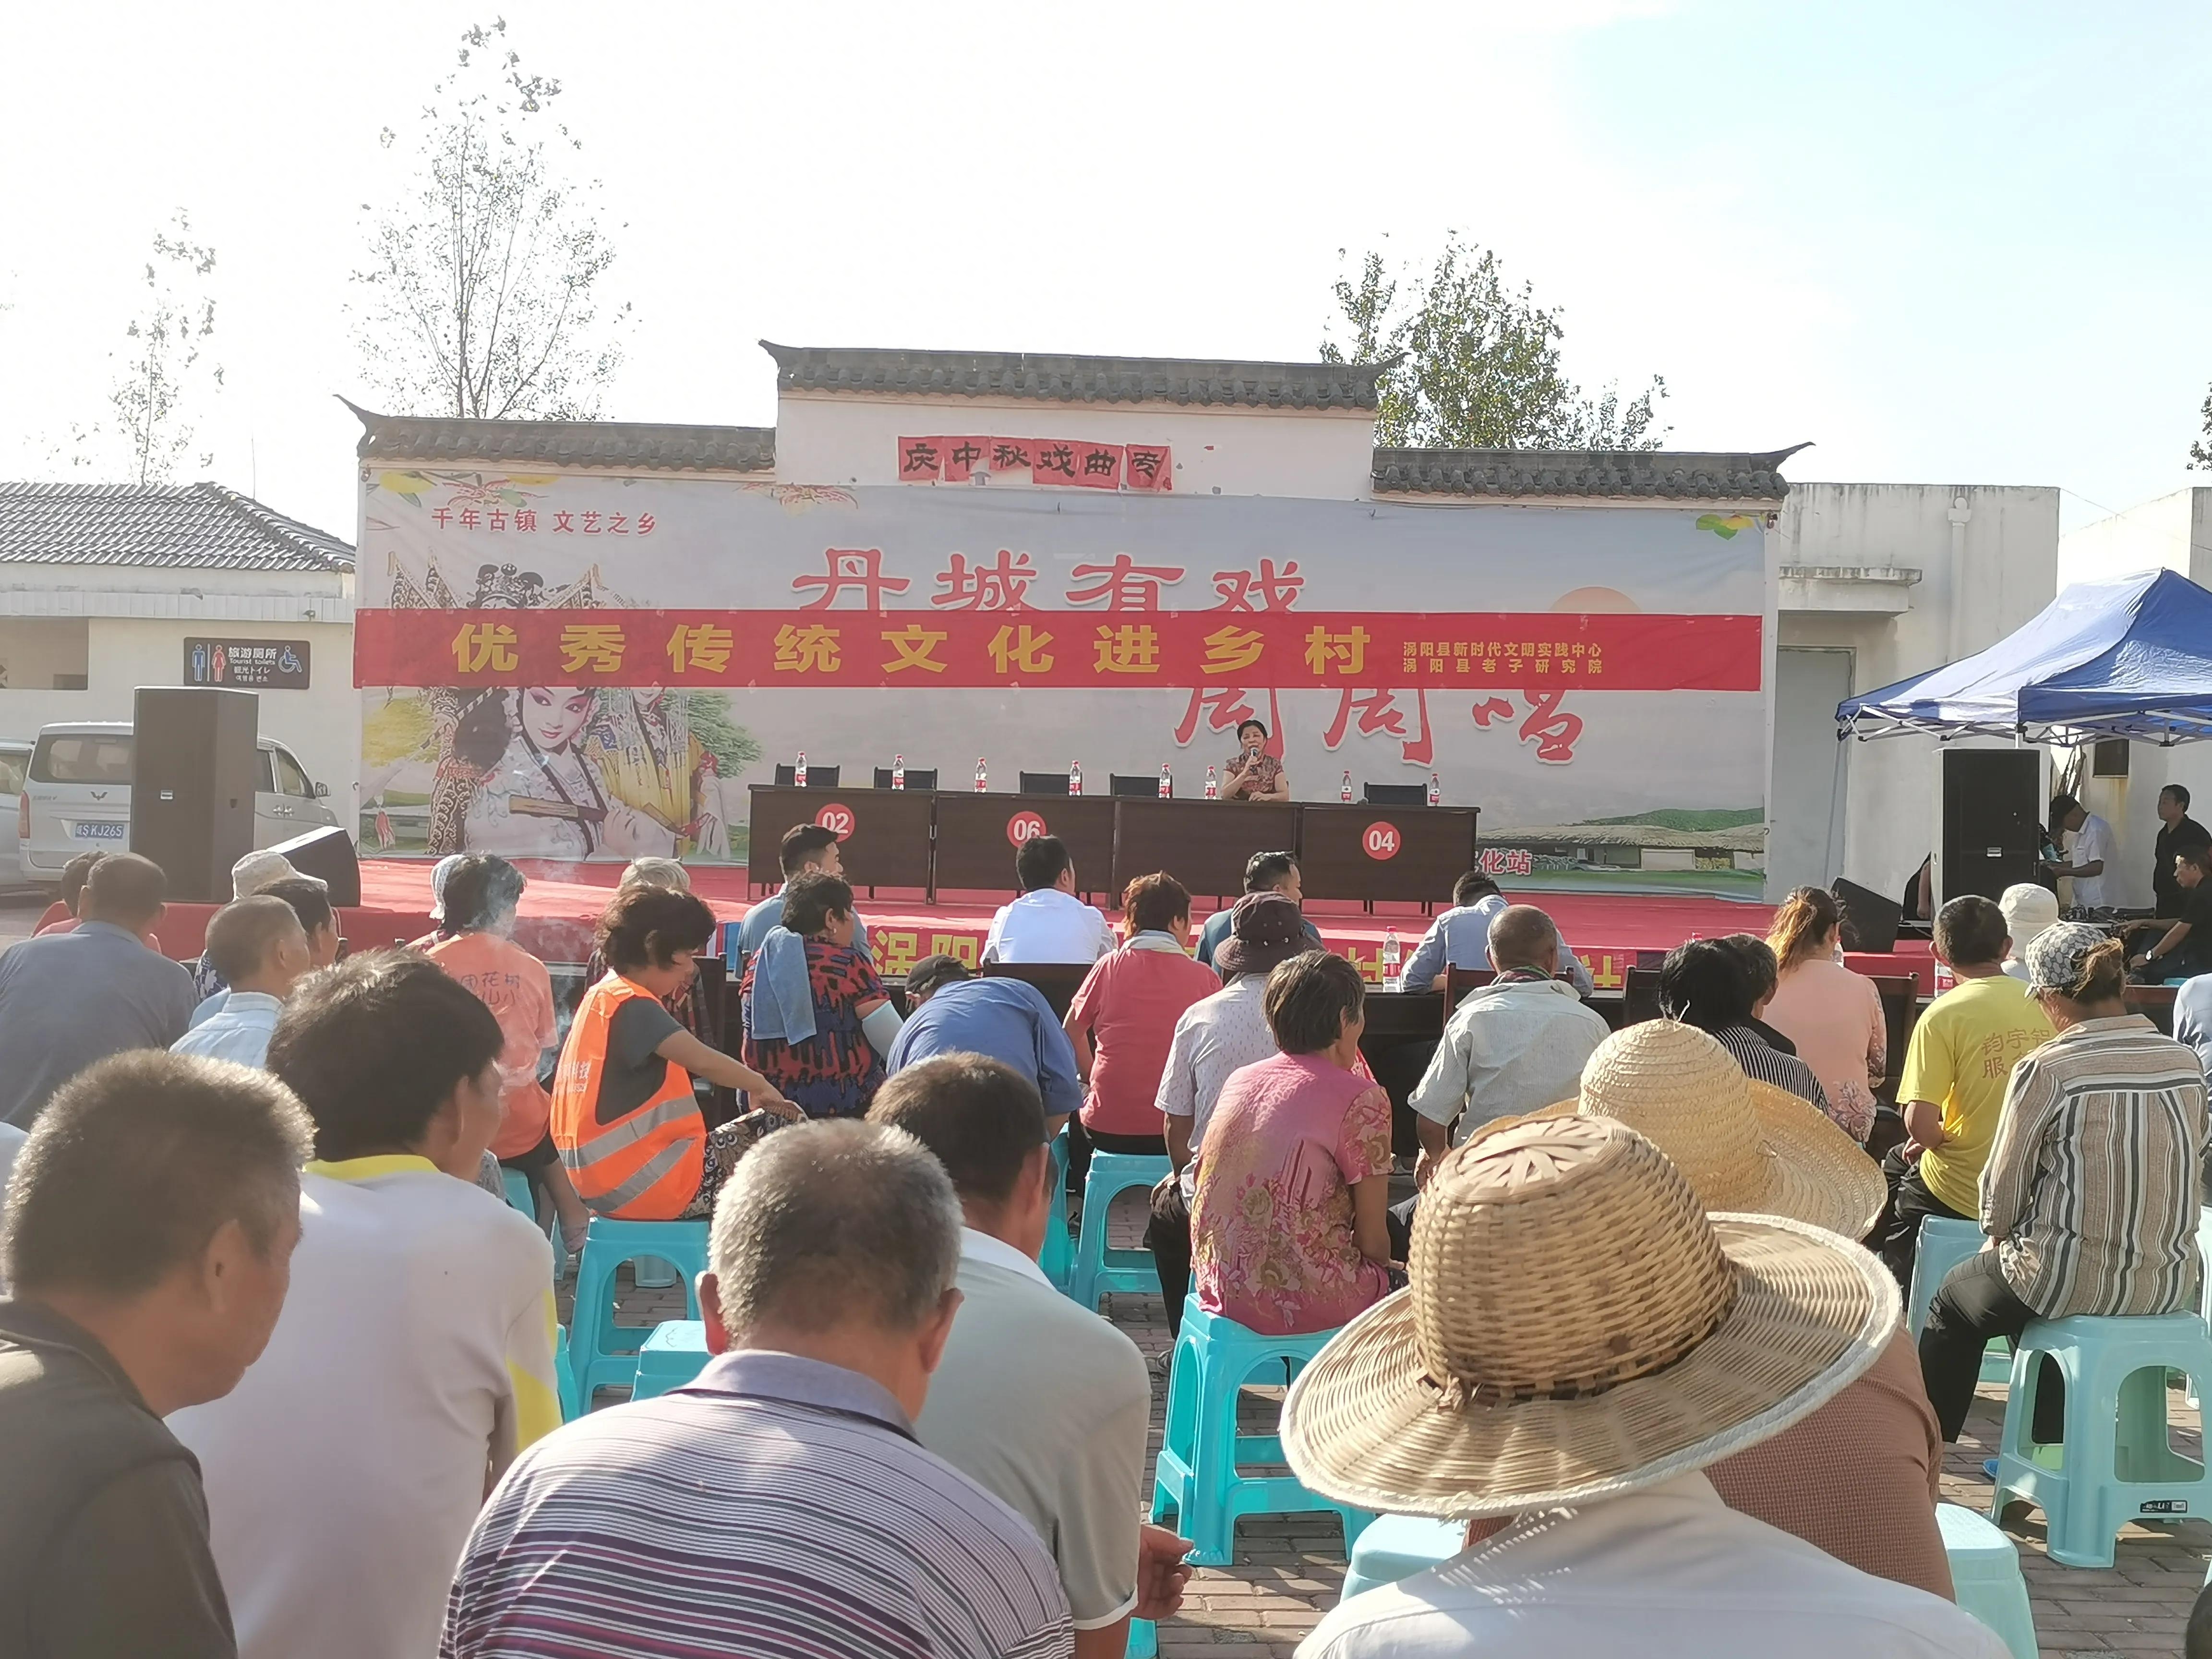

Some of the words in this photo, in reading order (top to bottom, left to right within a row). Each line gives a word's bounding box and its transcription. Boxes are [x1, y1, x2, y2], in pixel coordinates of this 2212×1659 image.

[432, 507, 537, 532] 千年古镇
[552, 510, 657, 535] 文艺之乡
[792, 548, 1305, 613] 丹城有戏
[228, 647, 276, 659] 旅游厕所
[451, 623, 1370, 675] 优秀传统文化进乡村
[1403, 641, 1602, 658] 涡阳县新时代文明实践中心
[1403, 658, 1602, 674] 涡阳县老子研究院
[822, 812, 849, 834] 02
[1369, 830, 1395, 852] 04
[1475, 848, 1533, 875] 化站
